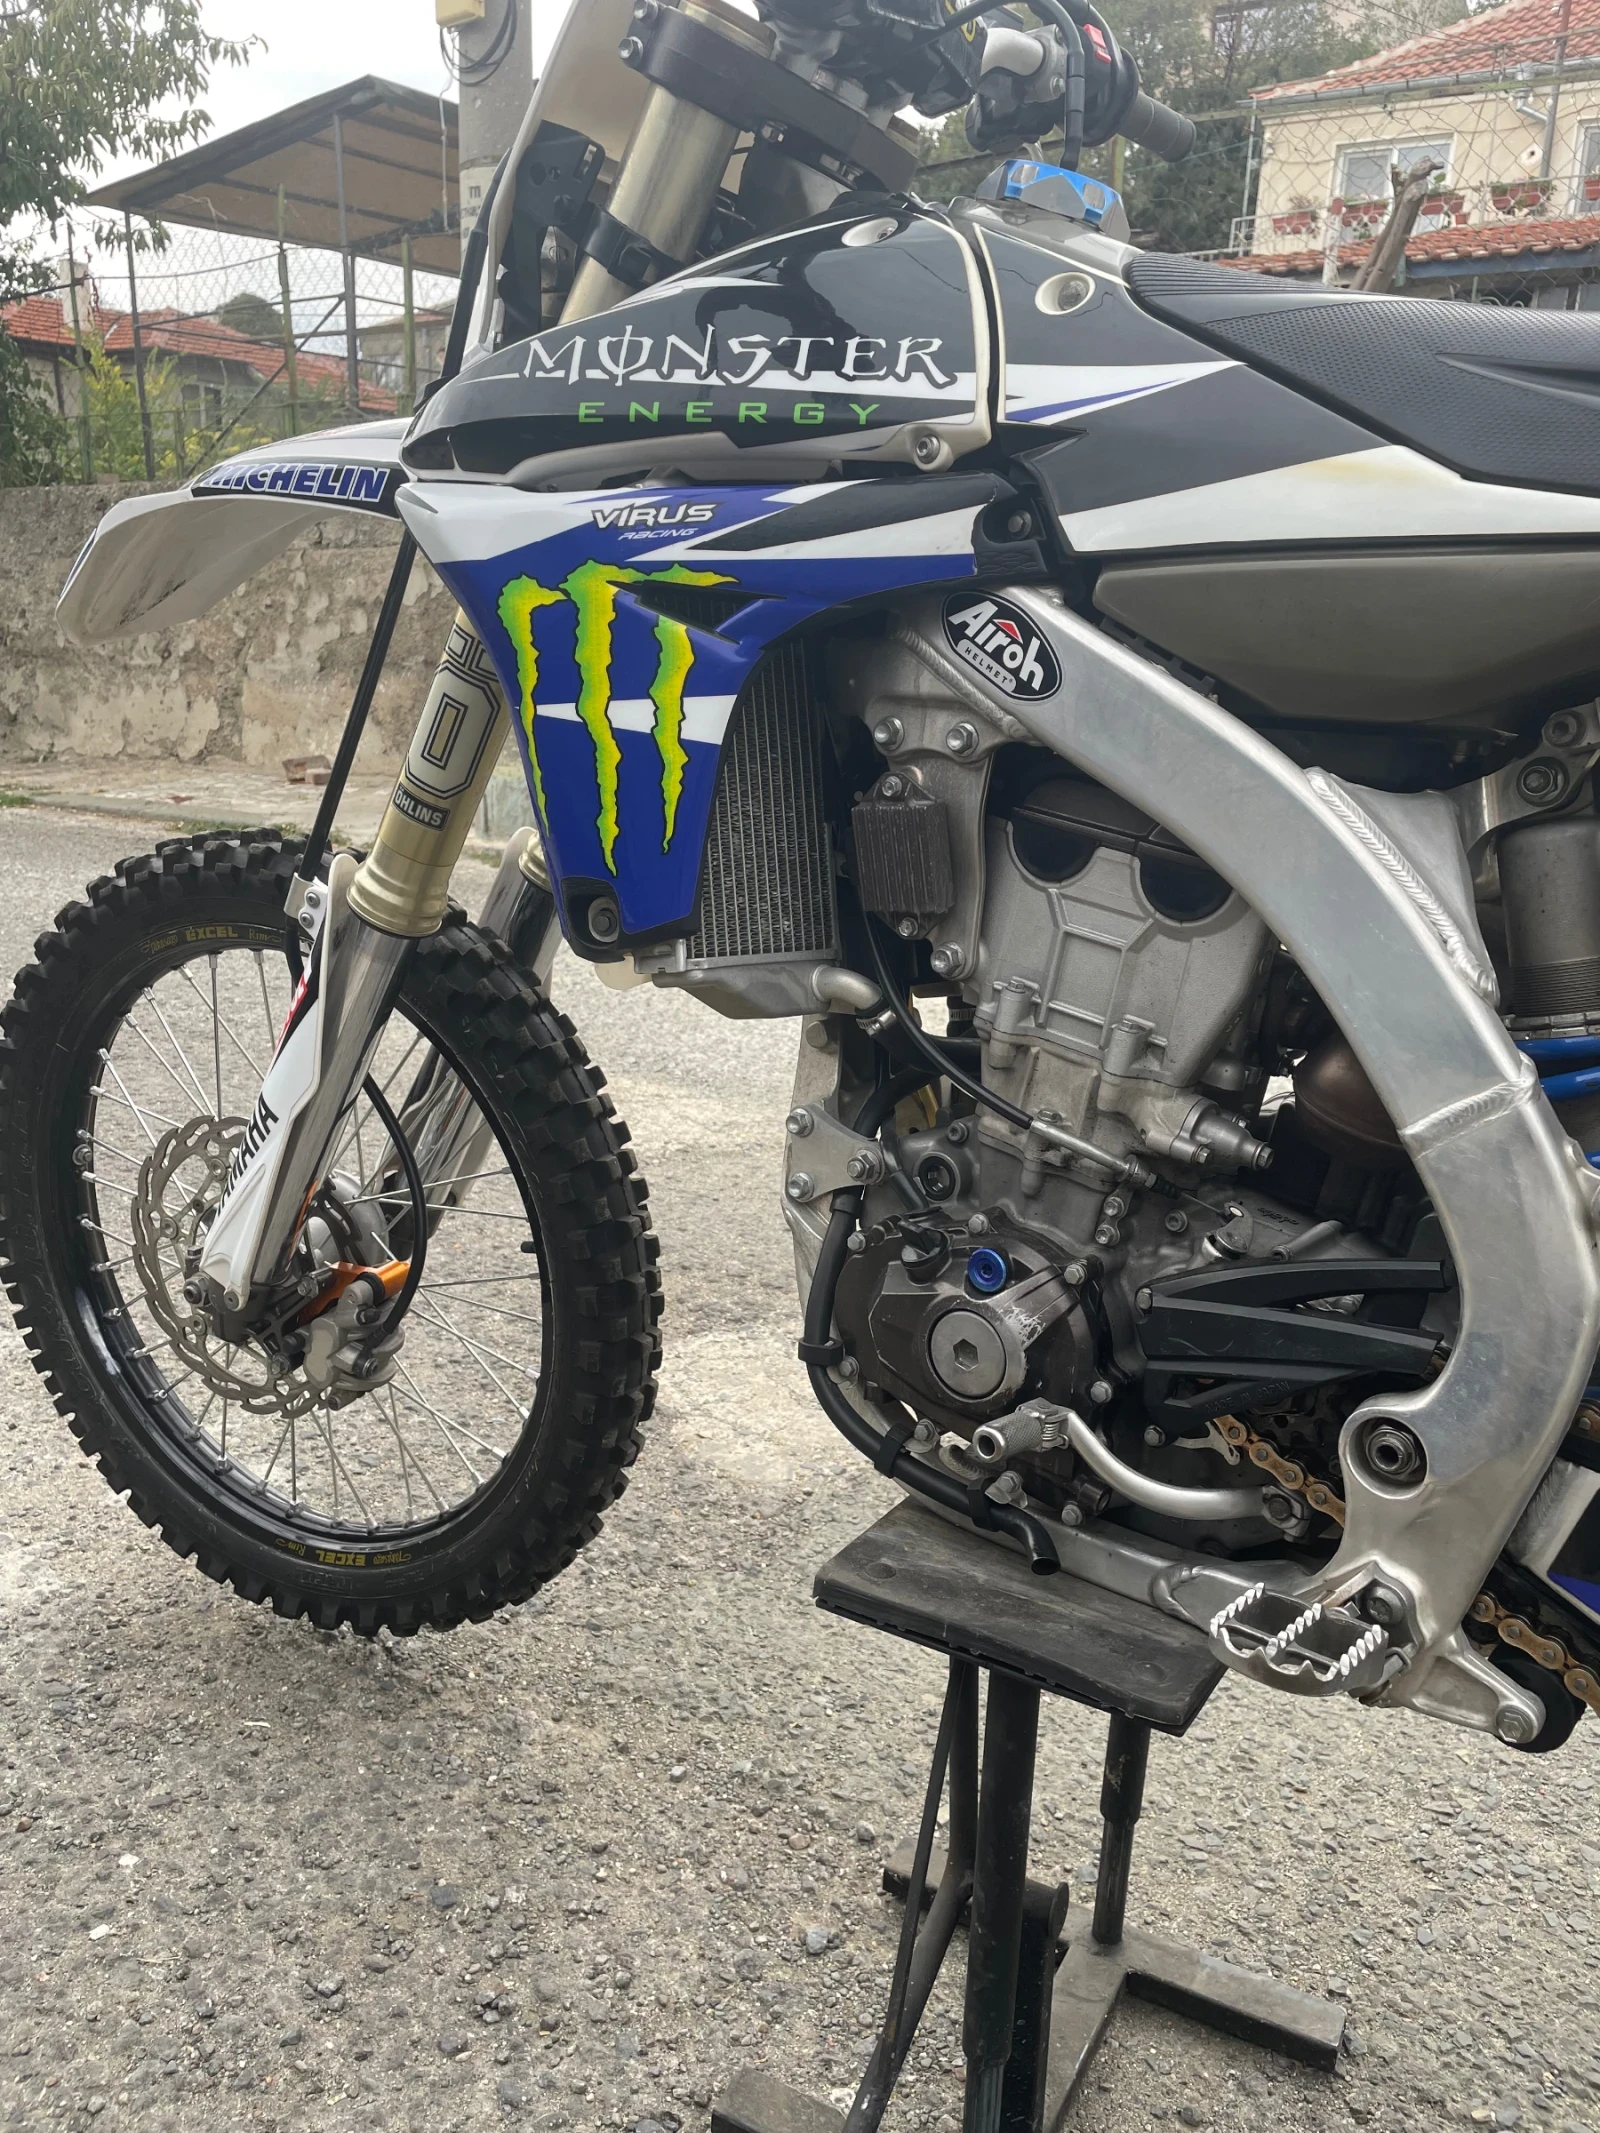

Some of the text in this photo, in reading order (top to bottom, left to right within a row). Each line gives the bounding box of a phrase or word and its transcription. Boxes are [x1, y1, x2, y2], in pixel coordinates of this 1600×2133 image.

[579, 401, 880, 425] ENERGY
[201, 463, 390, 502] MICHELIN
[593, 502, 718, 529] VIRUS
[618, 528, 699, 540] RACING
[948, 600, 1044, 691] Airoh
[965, 647, 1008, 685] HELMET
[185, 926, 238, 942] EXCEL
[316, 1550, 366, 1567] EXCEL
